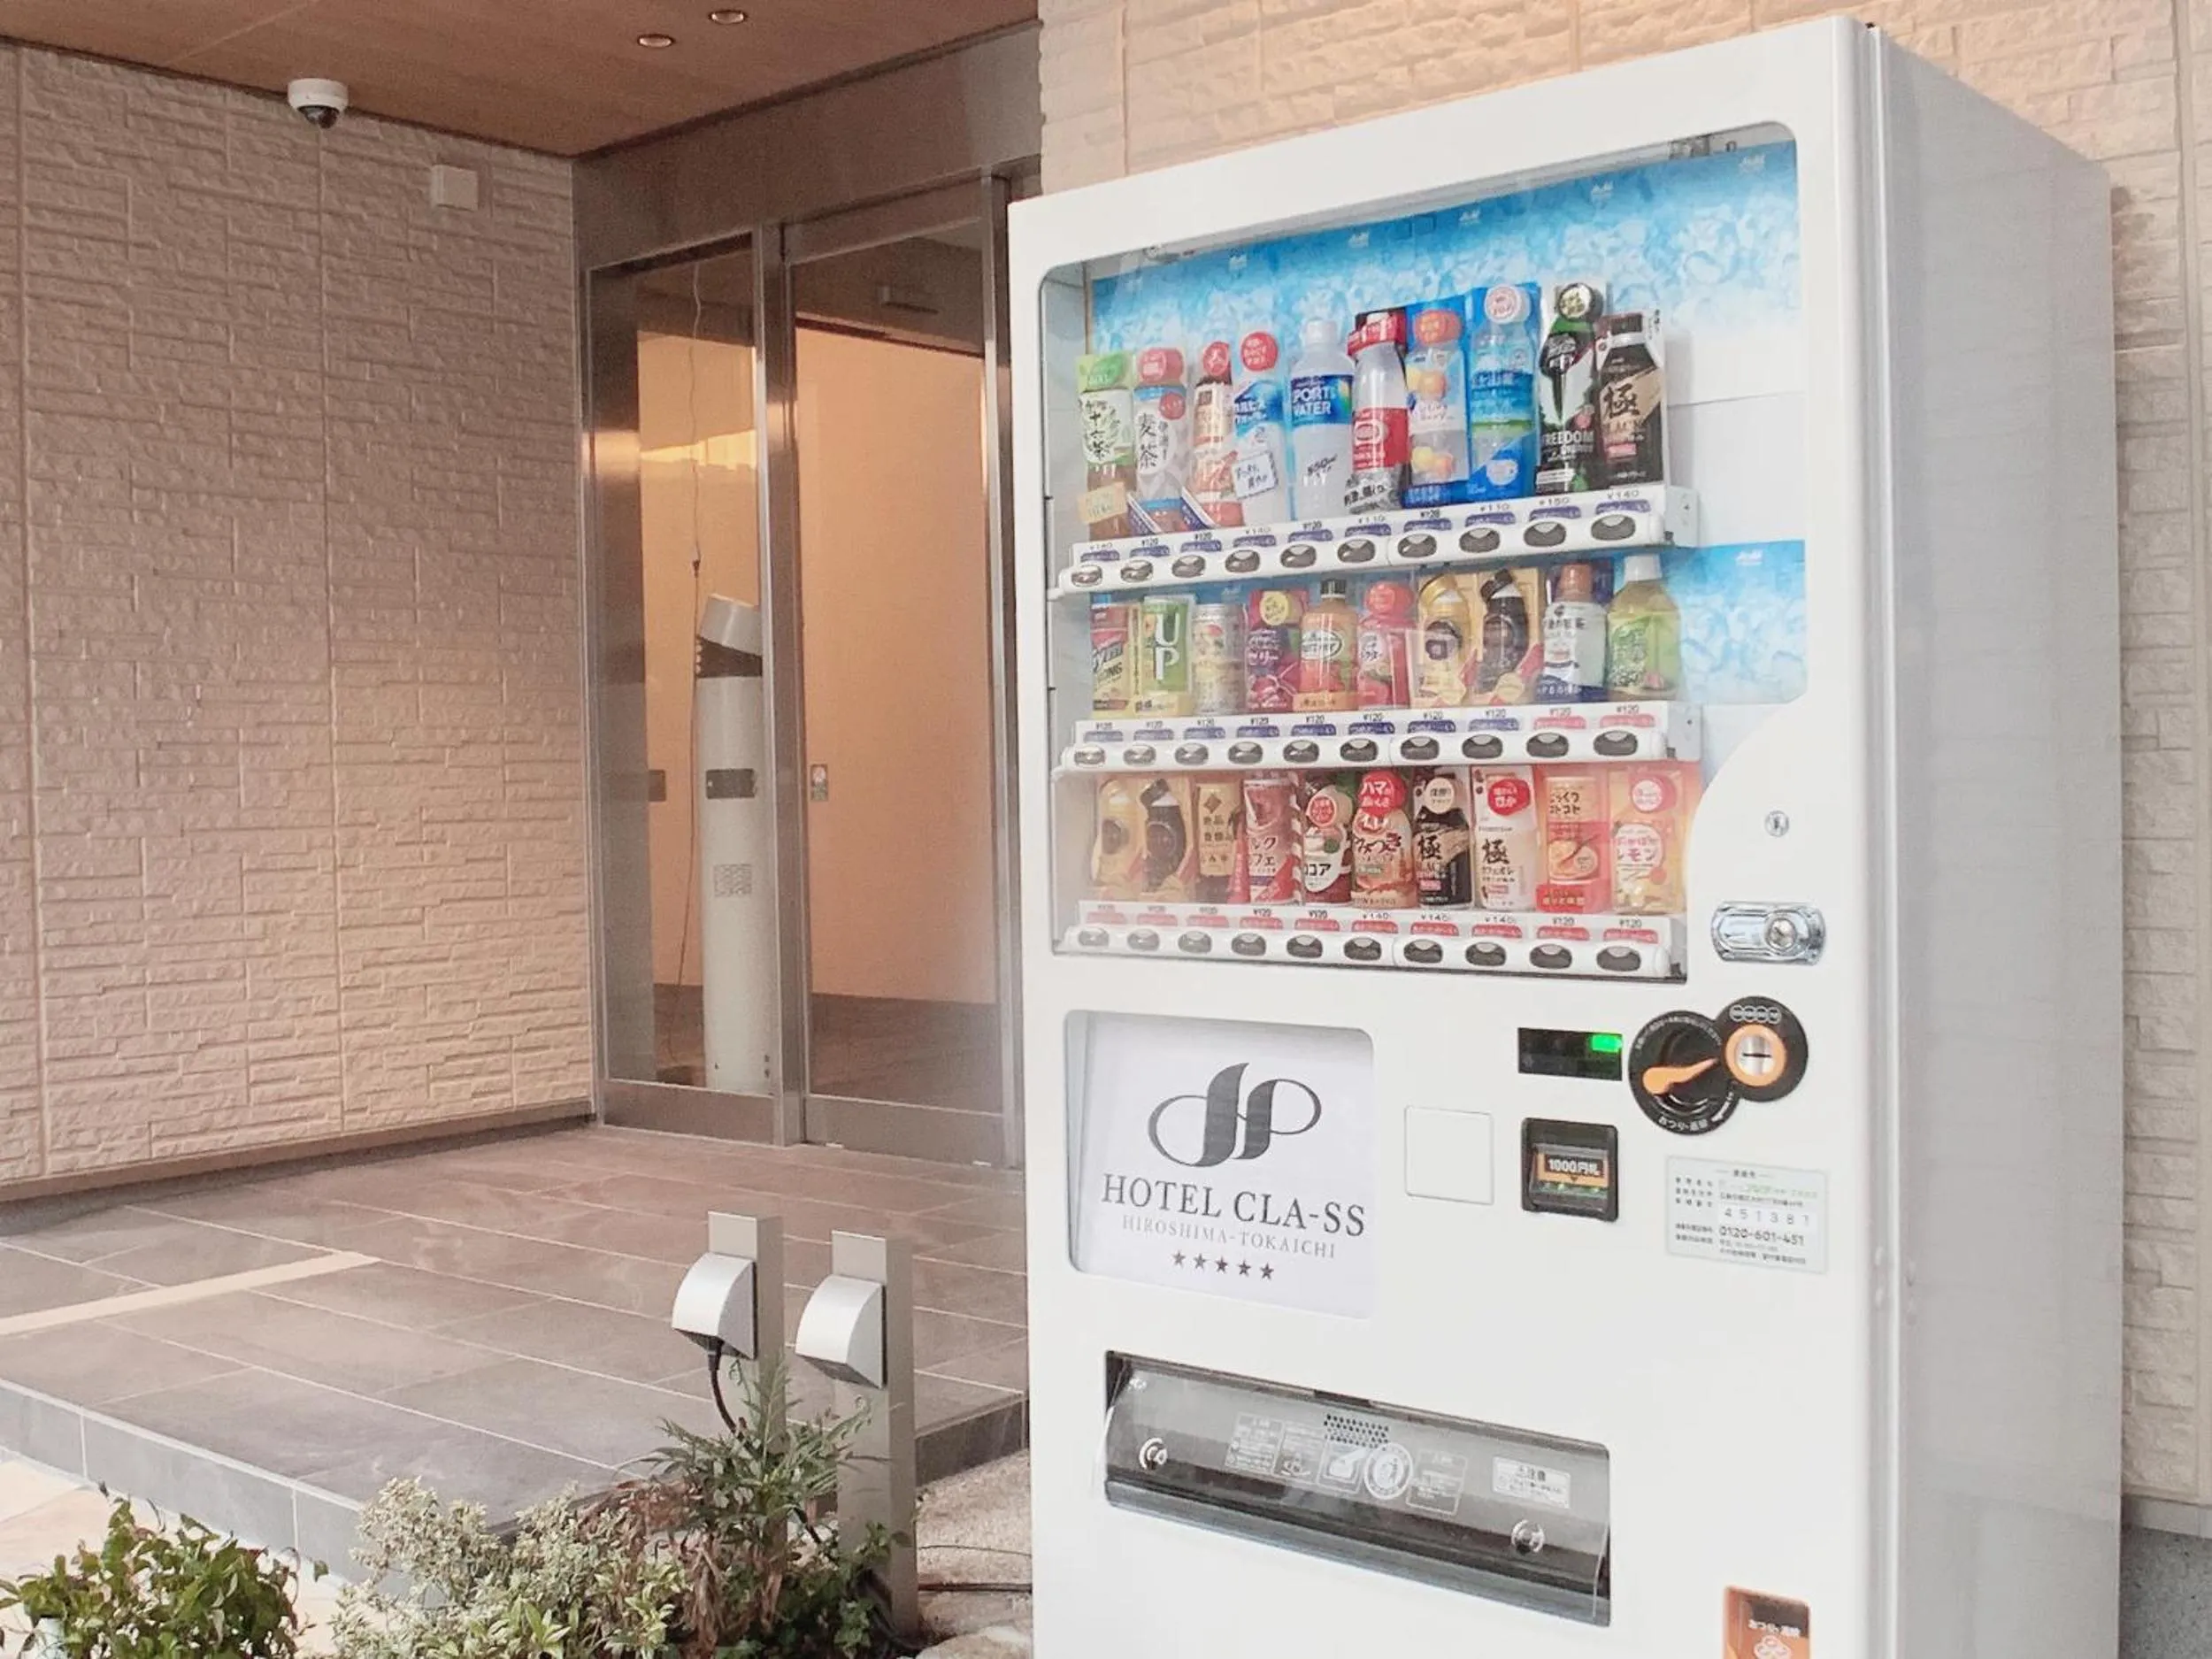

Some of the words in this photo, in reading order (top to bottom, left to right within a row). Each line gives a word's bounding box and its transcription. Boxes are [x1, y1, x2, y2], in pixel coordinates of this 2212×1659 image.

[1481, 838, 1510, 864] 極
[1101, 1173, 1223, 1217] HOTEL
[1233, 1191, 1367, 1237] CLA-SS
